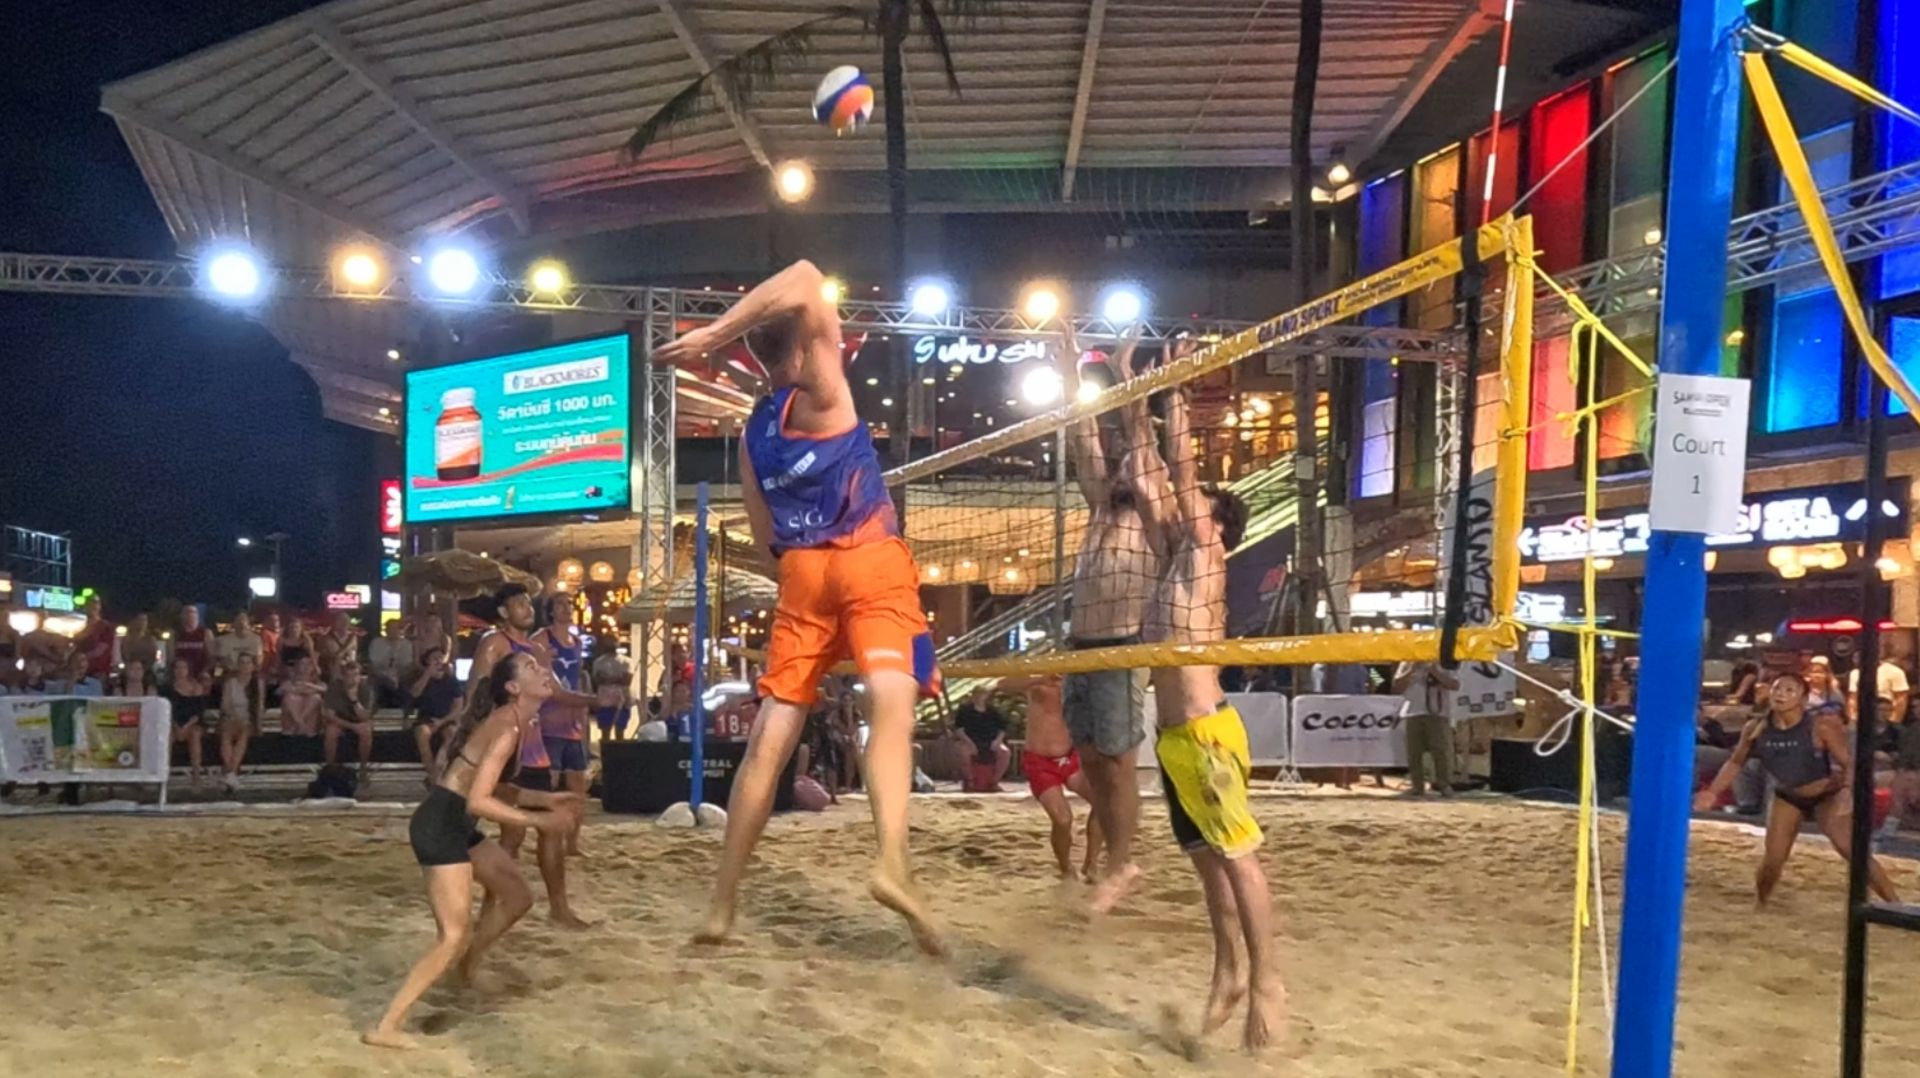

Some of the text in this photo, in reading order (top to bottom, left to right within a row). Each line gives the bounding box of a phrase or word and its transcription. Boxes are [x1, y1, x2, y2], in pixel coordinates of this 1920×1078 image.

[523, 366, 603, 389] BLACKMORES
[554, 396, 590, 412] 1000
[1672, 433, 1726, 455] Court
[1691, 475, 1701, 495] 1
[718, 713, 740, 734] 18
[678, 759, 733, 769] CETRAL
